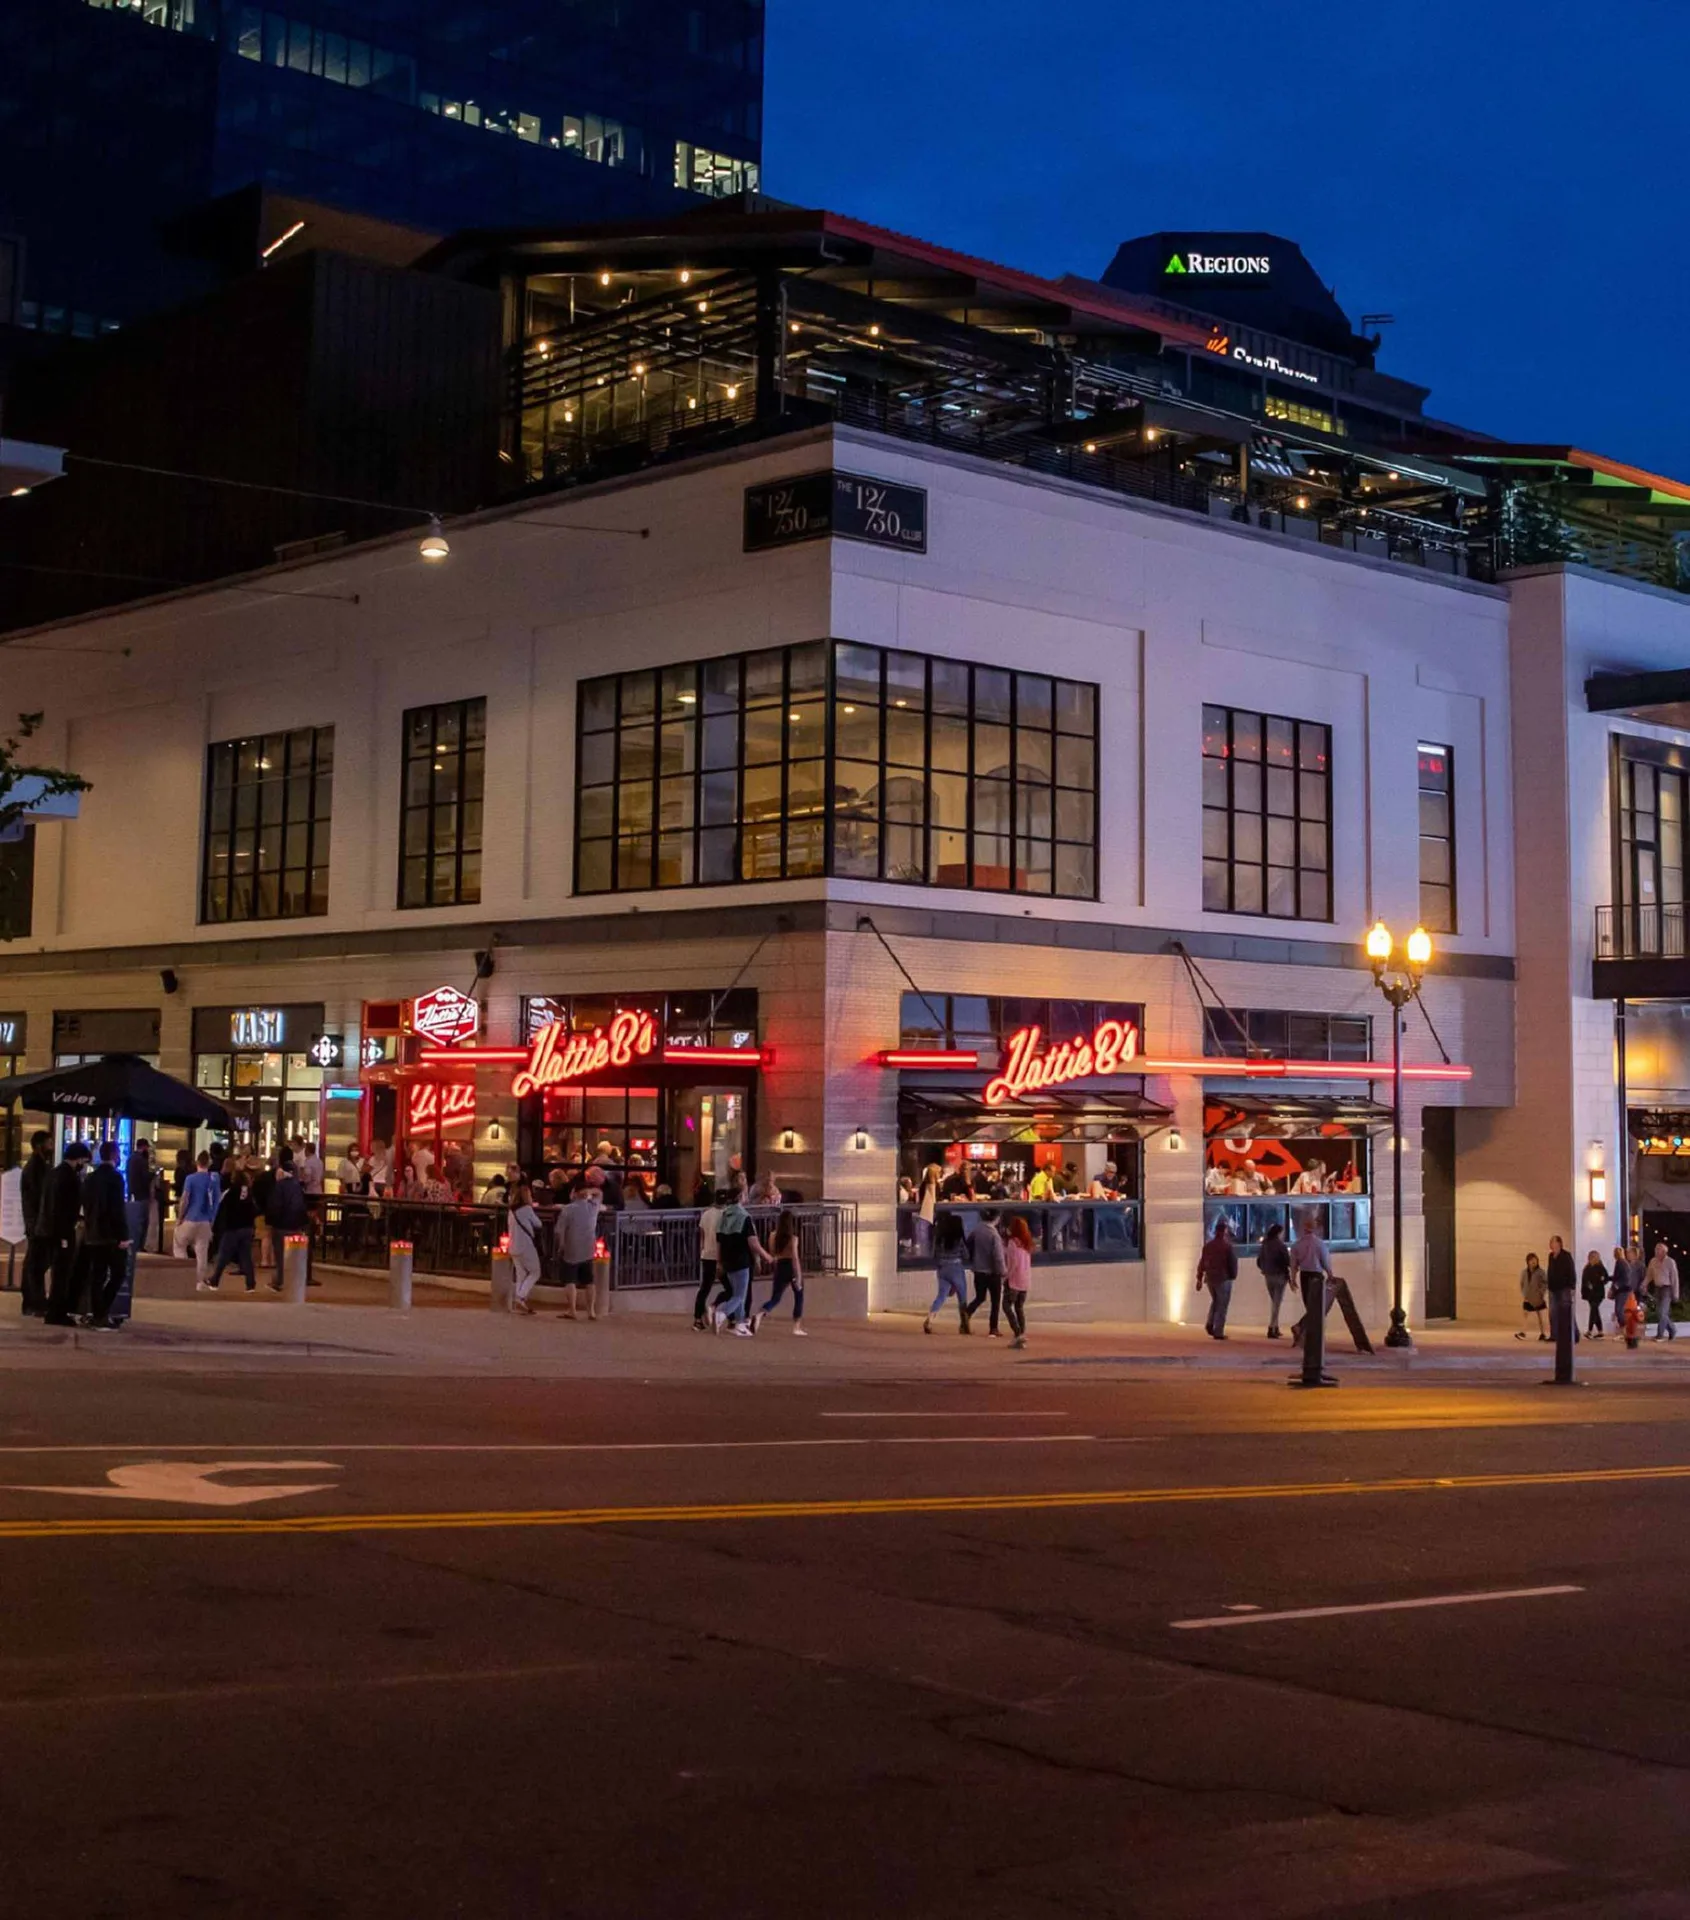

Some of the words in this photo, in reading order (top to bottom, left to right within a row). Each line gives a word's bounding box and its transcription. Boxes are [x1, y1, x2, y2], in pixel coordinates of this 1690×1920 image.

[1187, 252, 1271, 274] REGIONS
[511, 1021, 609, 1098] Hattie
[609, 1010, 655, 1067] B's
[985, 1024, 1093, 1105] Hattie
[1094, 1019, 1139, 1075] B's
